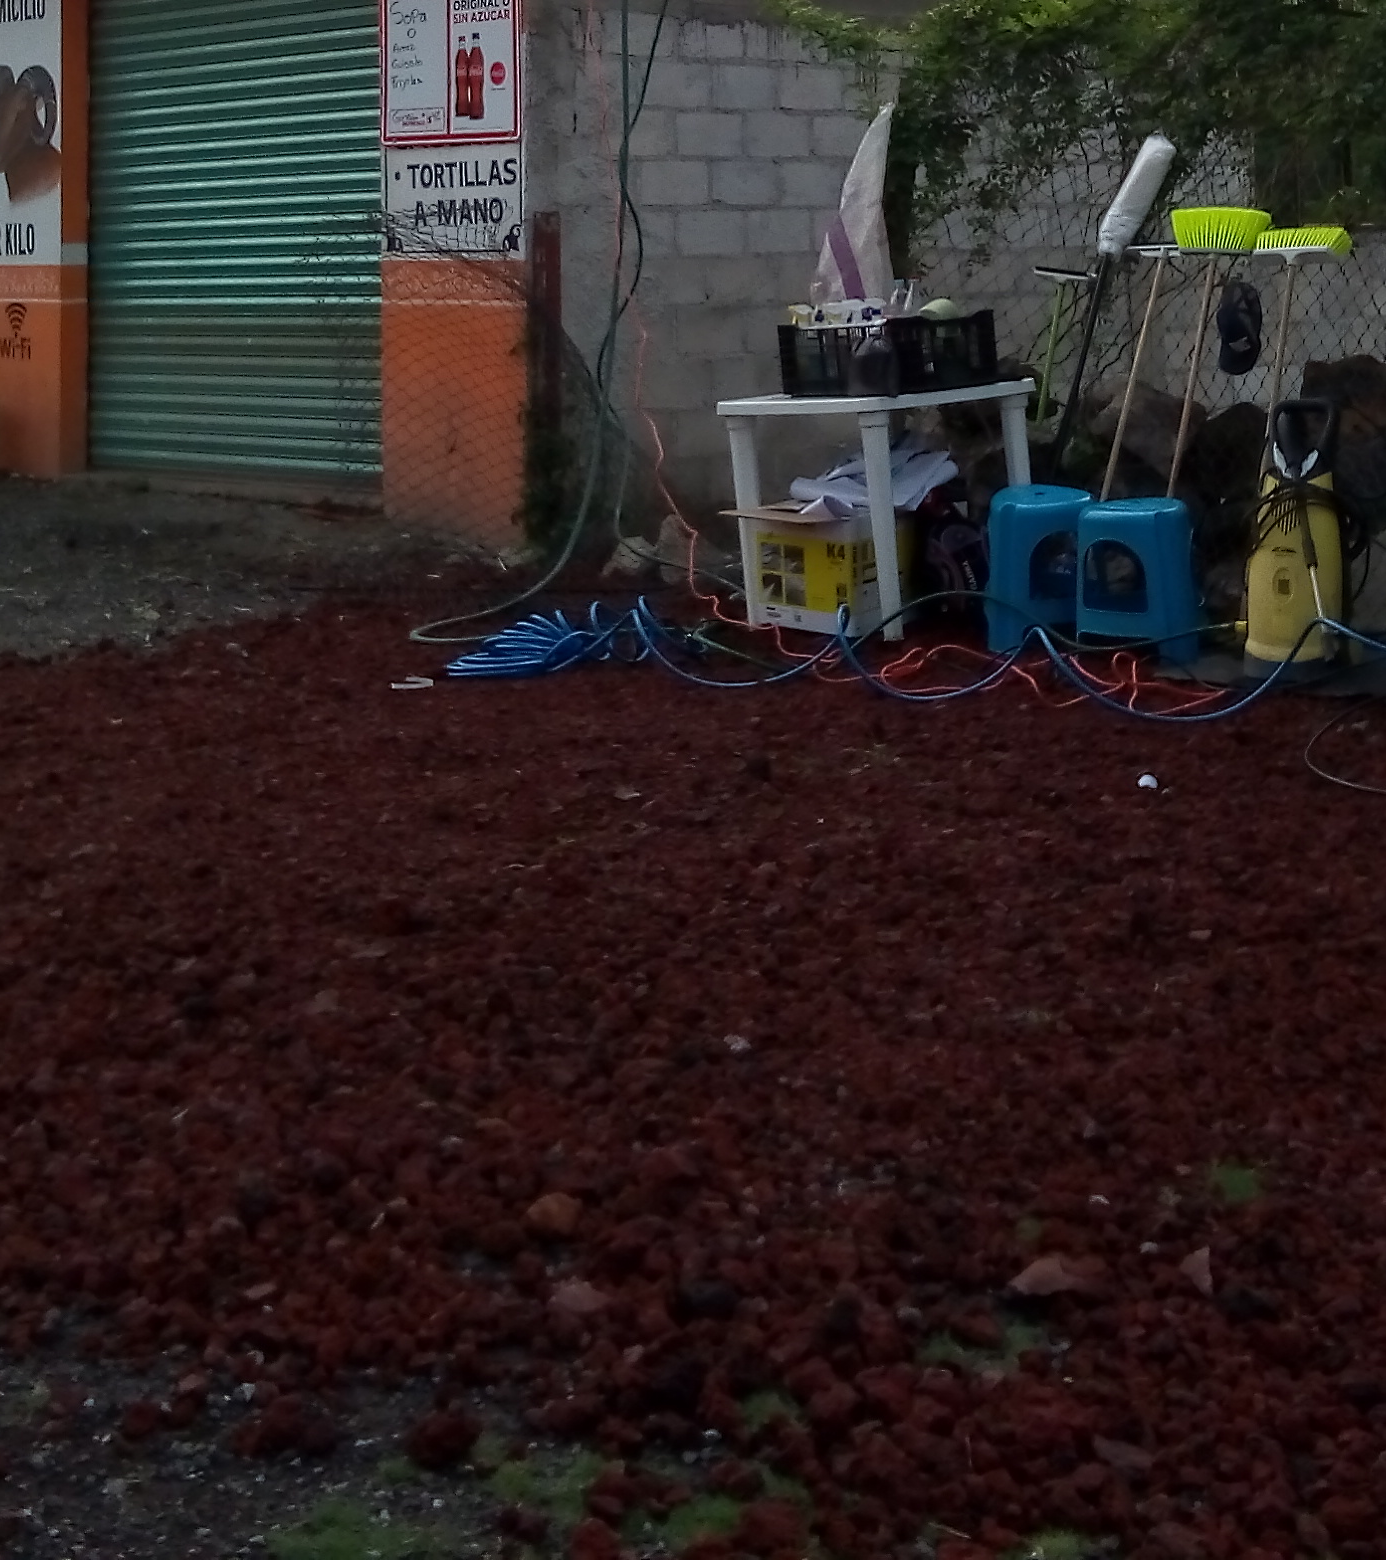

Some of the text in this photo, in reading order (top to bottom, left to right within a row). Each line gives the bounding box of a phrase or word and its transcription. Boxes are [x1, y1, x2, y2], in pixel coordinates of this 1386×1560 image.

[453, 13, 469, 24] SIN
[406, 157, 518, 190] TORTILLAS
[414, 197, 504, 227] A MANO
[5, 223, 35, 257] KILO
